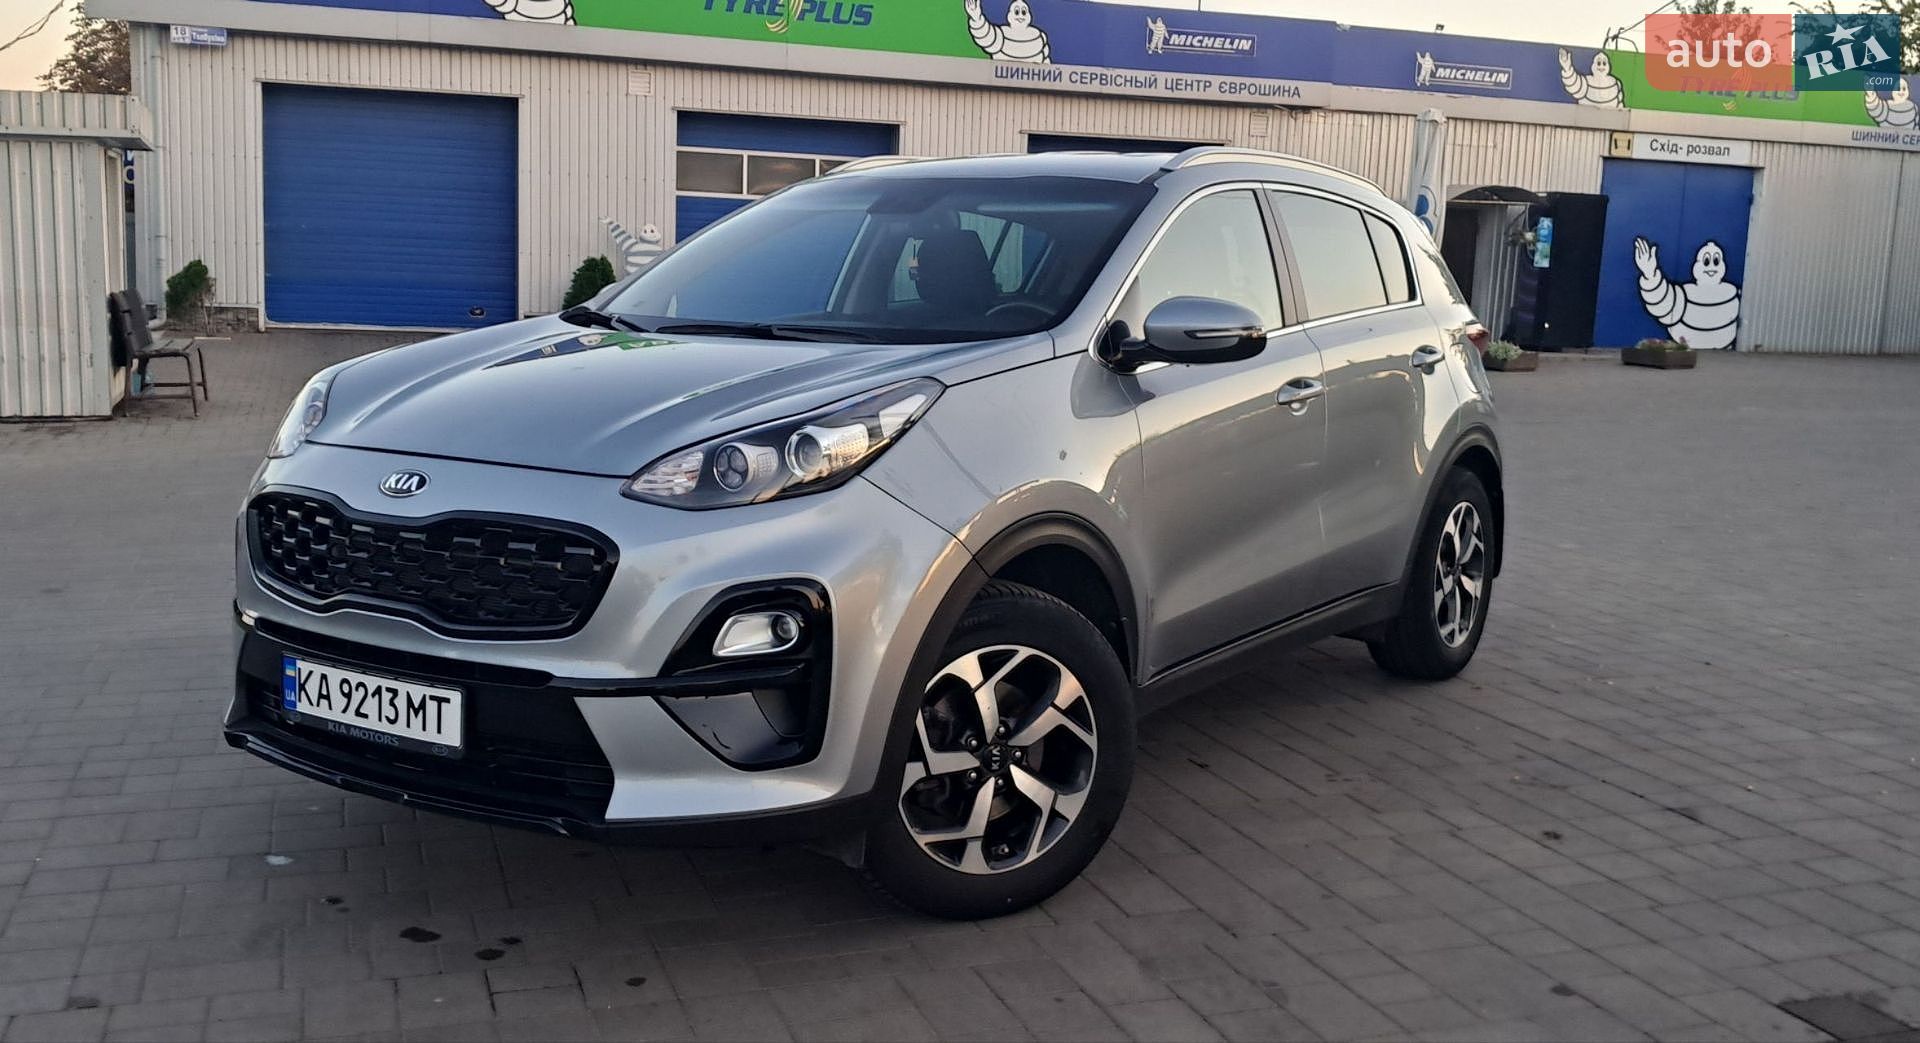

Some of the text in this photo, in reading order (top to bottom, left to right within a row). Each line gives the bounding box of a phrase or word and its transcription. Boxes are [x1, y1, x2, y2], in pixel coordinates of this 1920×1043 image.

[797, 2, 874, 26] PLUS
[1168, 33, 1253, 51] MICHELIN
[995, 65, 1301, 98] ШИННИЙ СЕРВІСНЫЙ ЦЕНТР ЄВРОШИНА
[1436, 67, 1509, 83] MICHELIN
[1852, 130, 1899, 144] ШИННИЙ
[1650, 138, 1730, 156] Схід- розвал
[385, 473, 420, 491] KIA
[285, 689, 296, 702] UA
[298, 667, 451, 735] KA 9213 MT
[327, 721, 400, 746] KIA MOTORS
